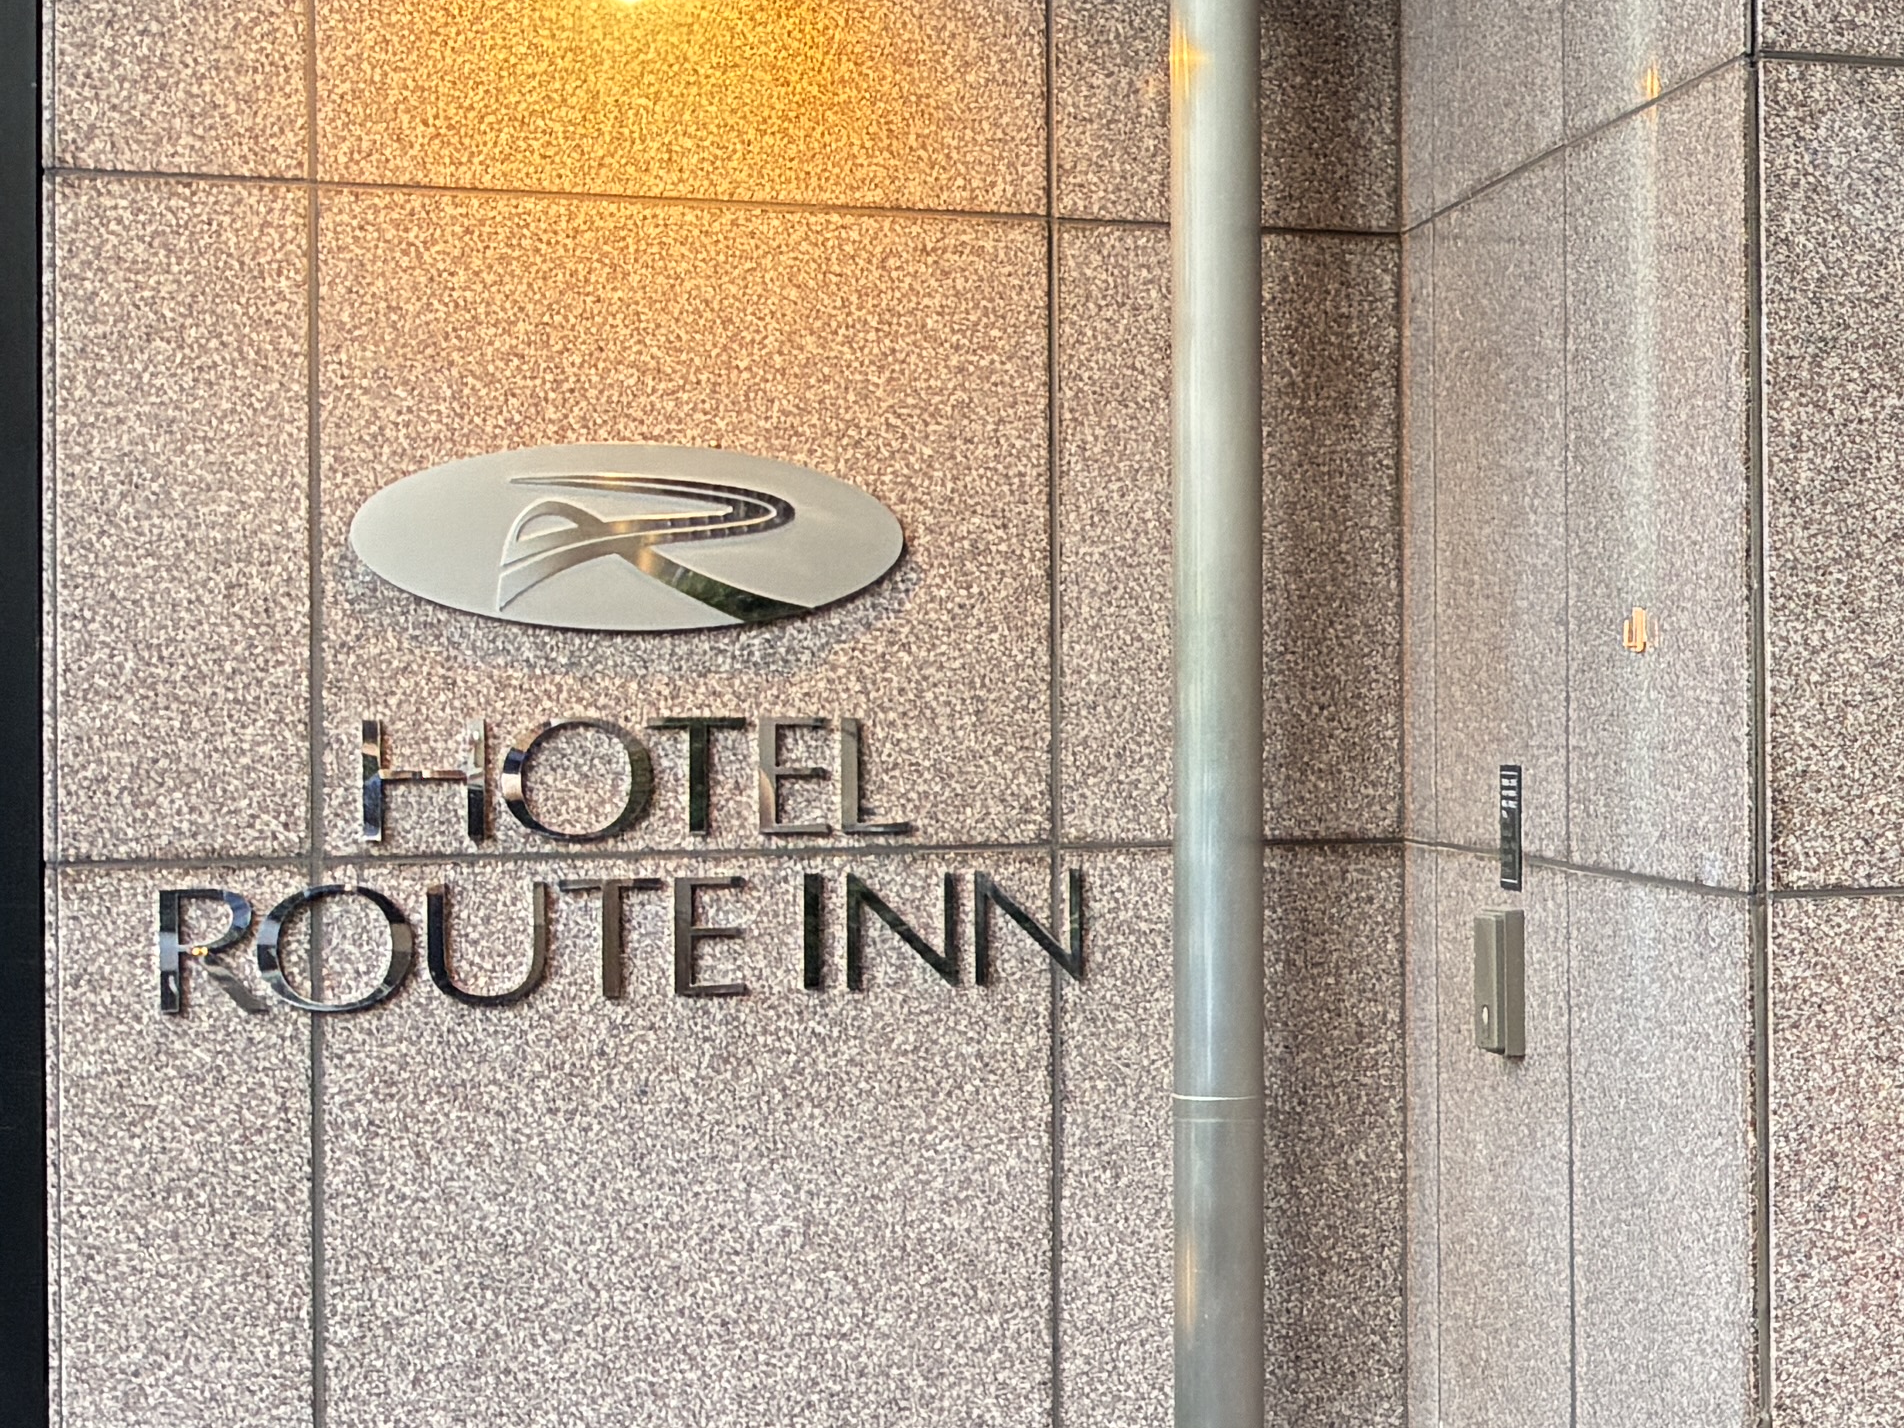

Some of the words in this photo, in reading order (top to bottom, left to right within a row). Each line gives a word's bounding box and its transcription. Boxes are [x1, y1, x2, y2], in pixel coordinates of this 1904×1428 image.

[360, 716, 911, 843] HOTEL
[157, 873, 748, 1015] ROUTE
[802, 868, 1085, 991] INN
